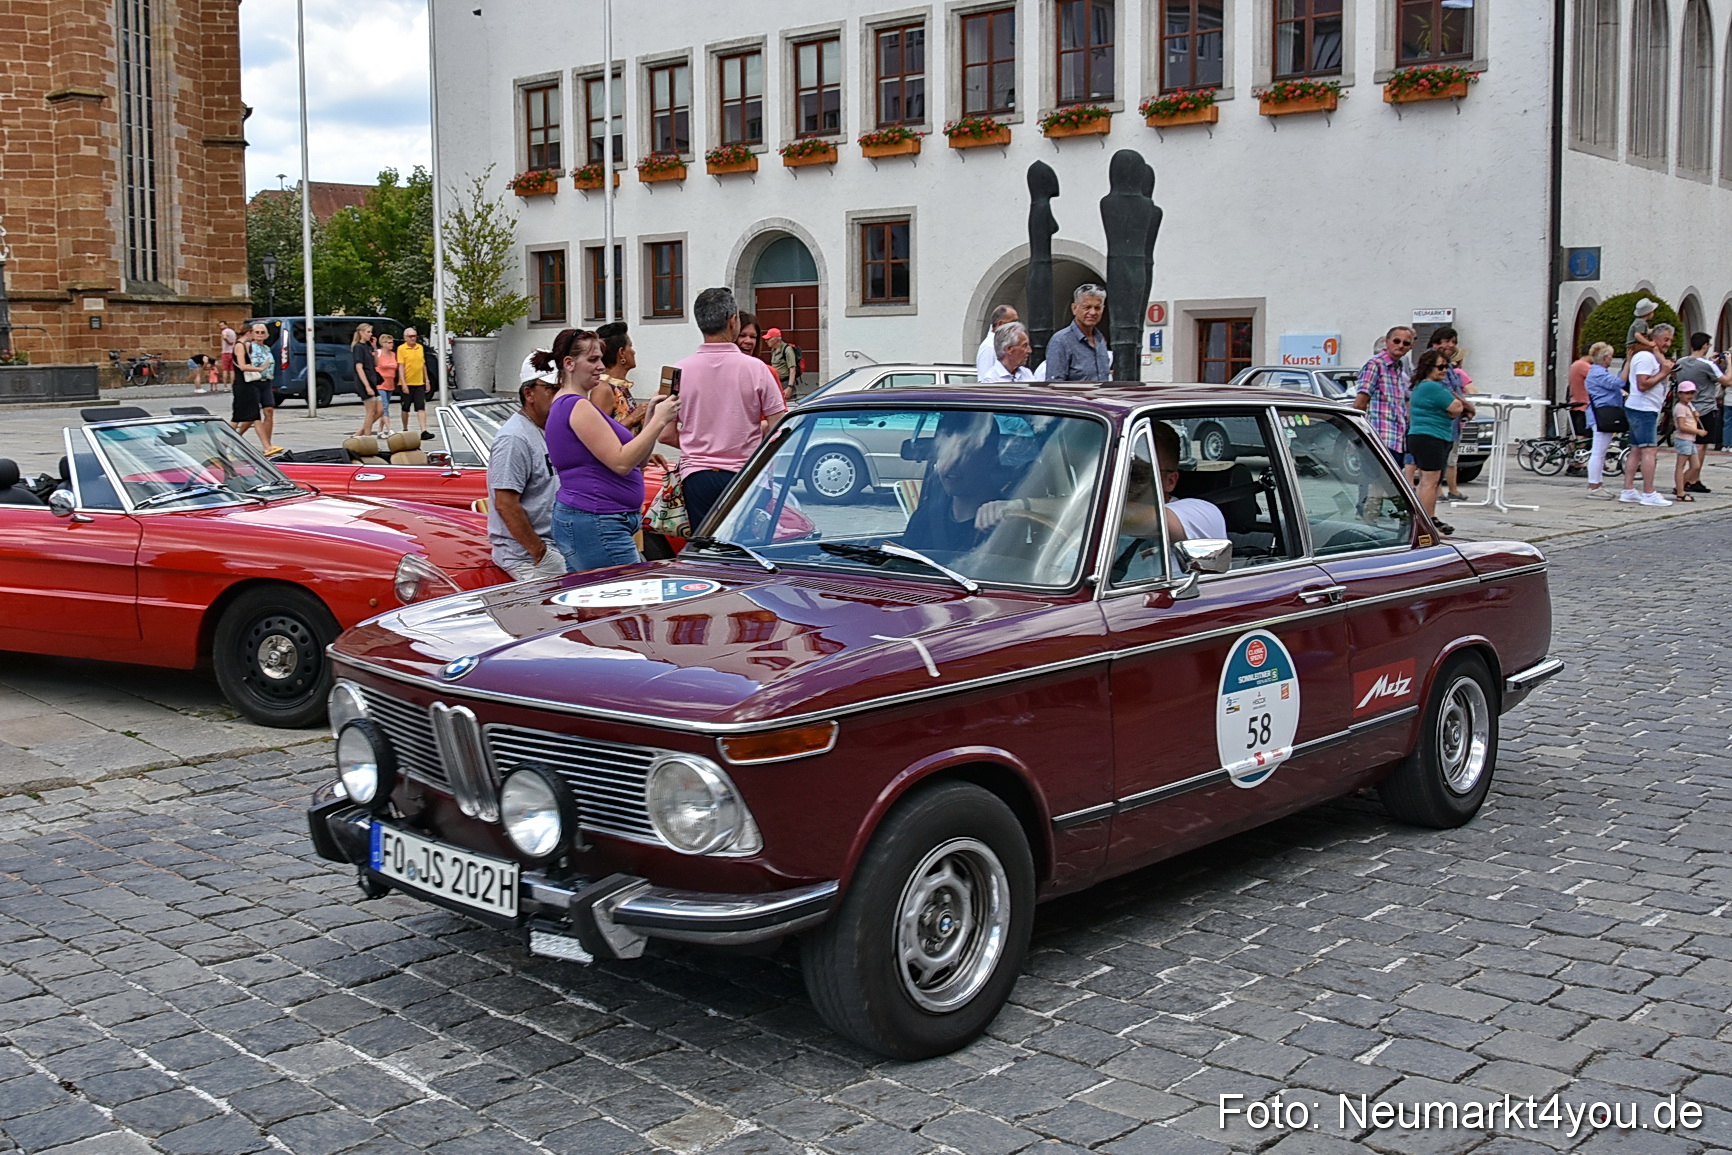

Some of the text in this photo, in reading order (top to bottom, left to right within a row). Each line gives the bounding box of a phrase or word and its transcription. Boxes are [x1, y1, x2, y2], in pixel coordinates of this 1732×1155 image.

[1282, 354, 1321, 365] Kunst
[1355, 671, 1413, 709] Metz
[1246, 712, 1271, 749] 58
[383, 833, 514, 910] FO JS 202H
